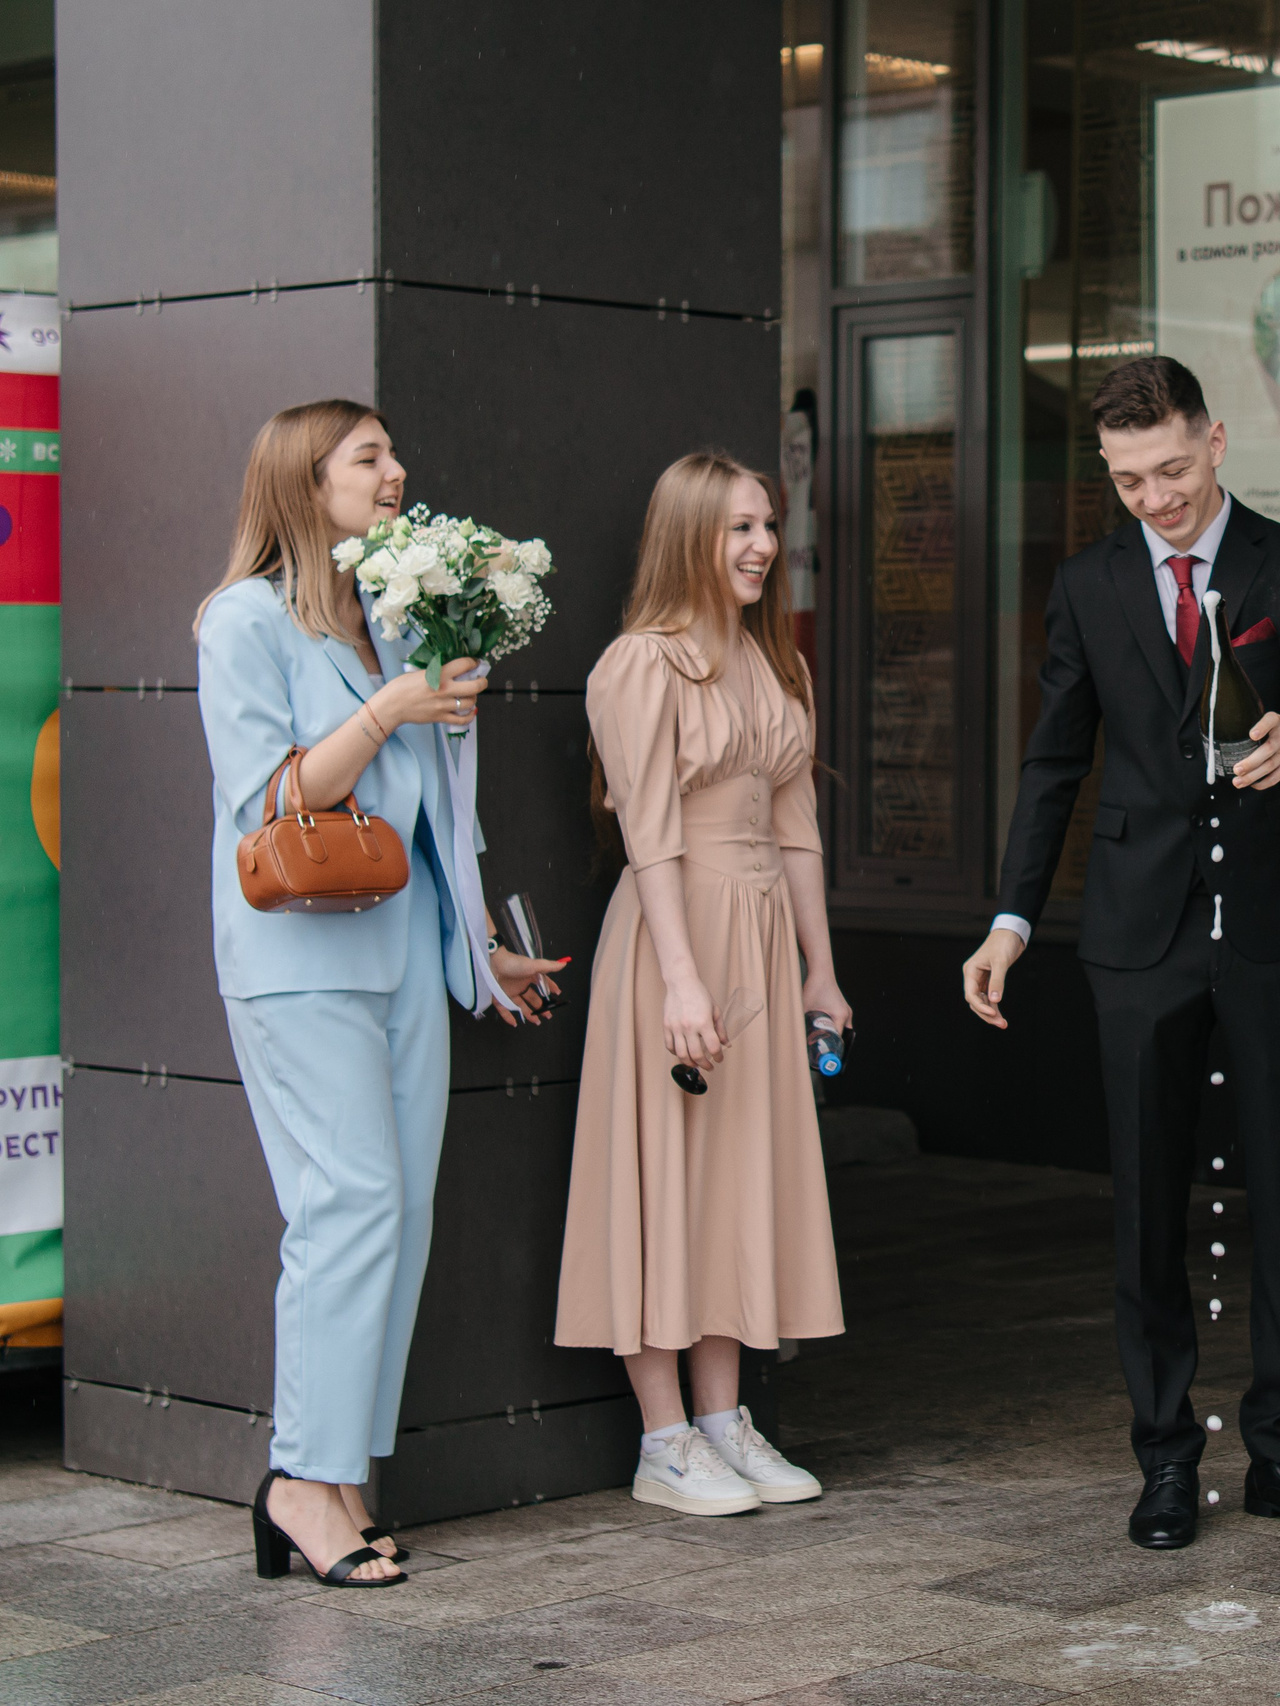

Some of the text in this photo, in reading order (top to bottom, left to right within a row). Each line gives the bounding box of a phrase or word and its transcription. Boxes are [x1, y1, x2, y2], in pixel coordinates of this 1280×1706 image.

[1177, 249, 1187, 262] в
[1191, 244, 1249, 261] самом
[0, 1130, 60, 1159] ЕСТ
